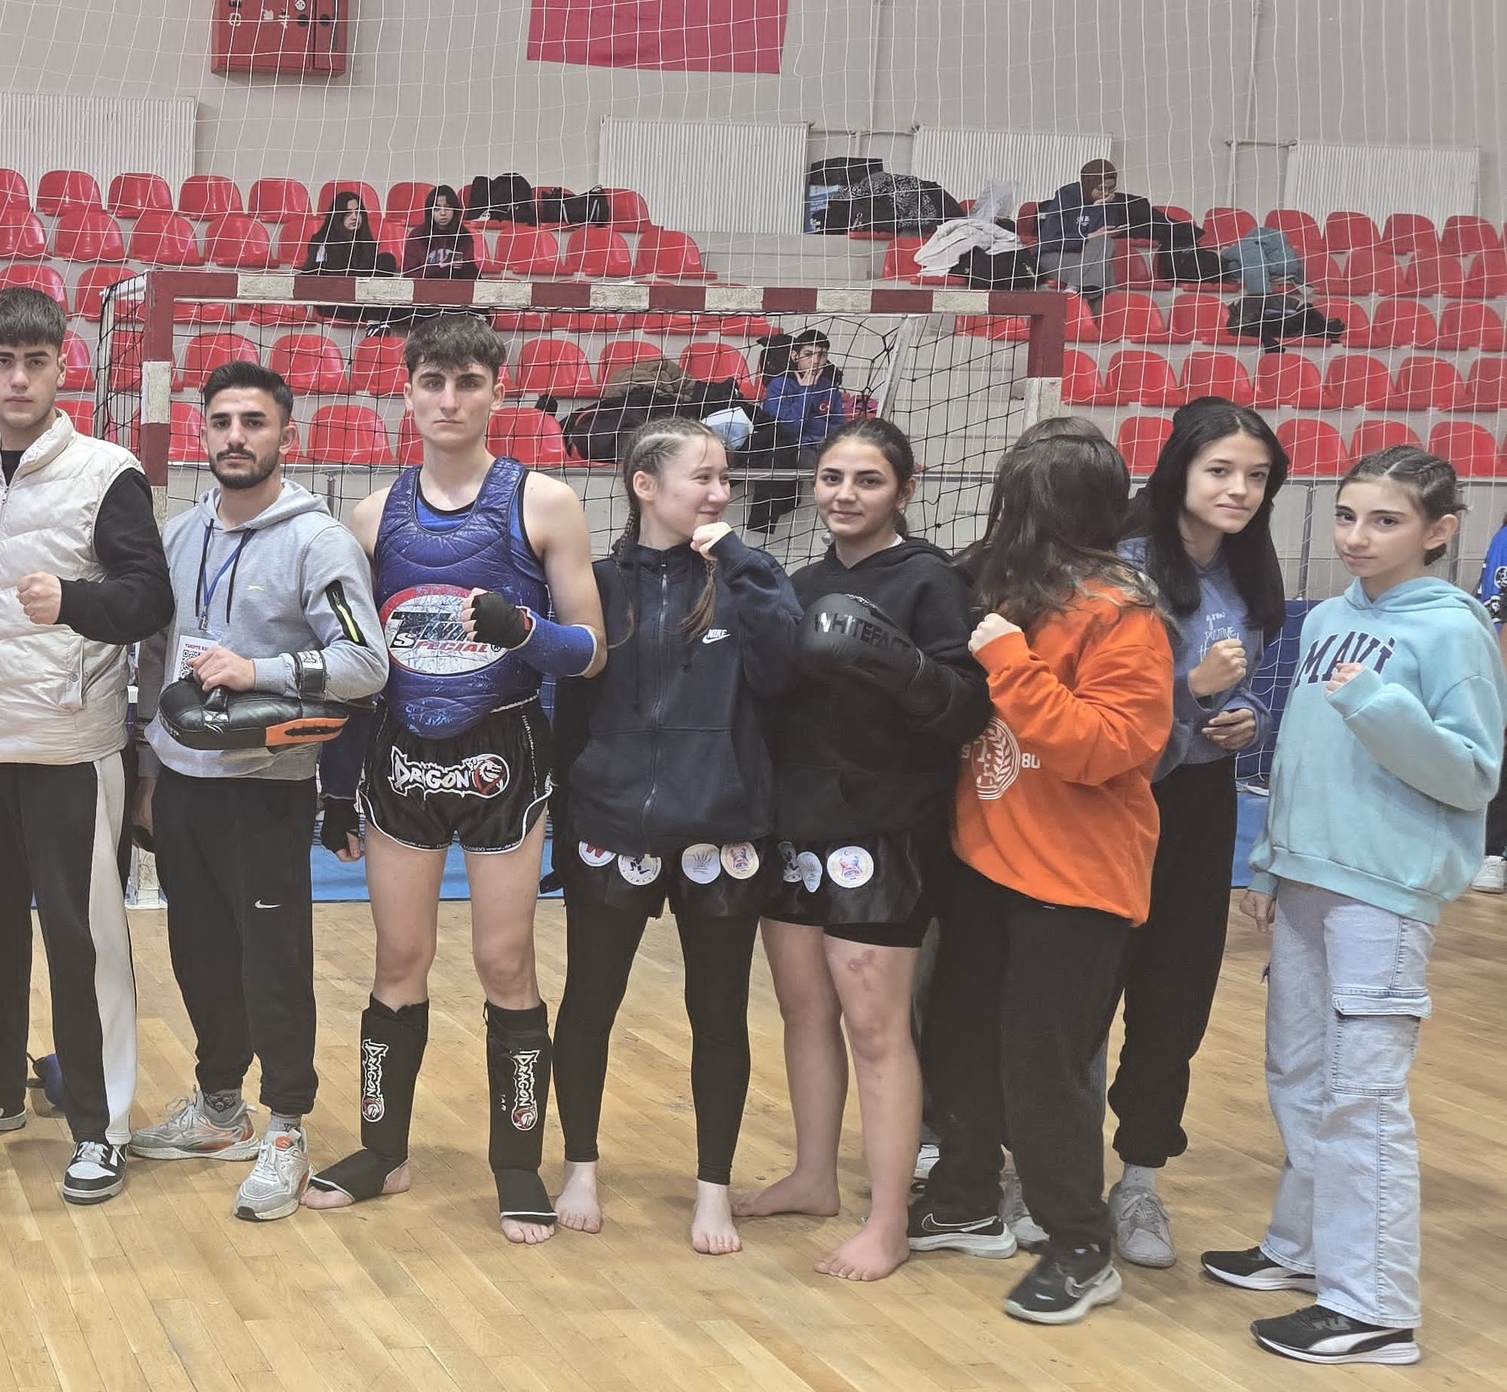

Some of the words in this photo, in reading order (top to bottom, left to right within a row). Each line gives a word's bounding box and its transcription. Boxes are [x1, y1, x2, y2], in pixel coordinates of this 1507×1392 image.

[393, 632, 489, 653] SPECIAL
[707, 629, 728, 638] NIKE
[393, 753, 471, 791] DRAGON
[364, 1042, 385, 1098] DRAGON
[513, 1054, 535, 1107] DRAGON
